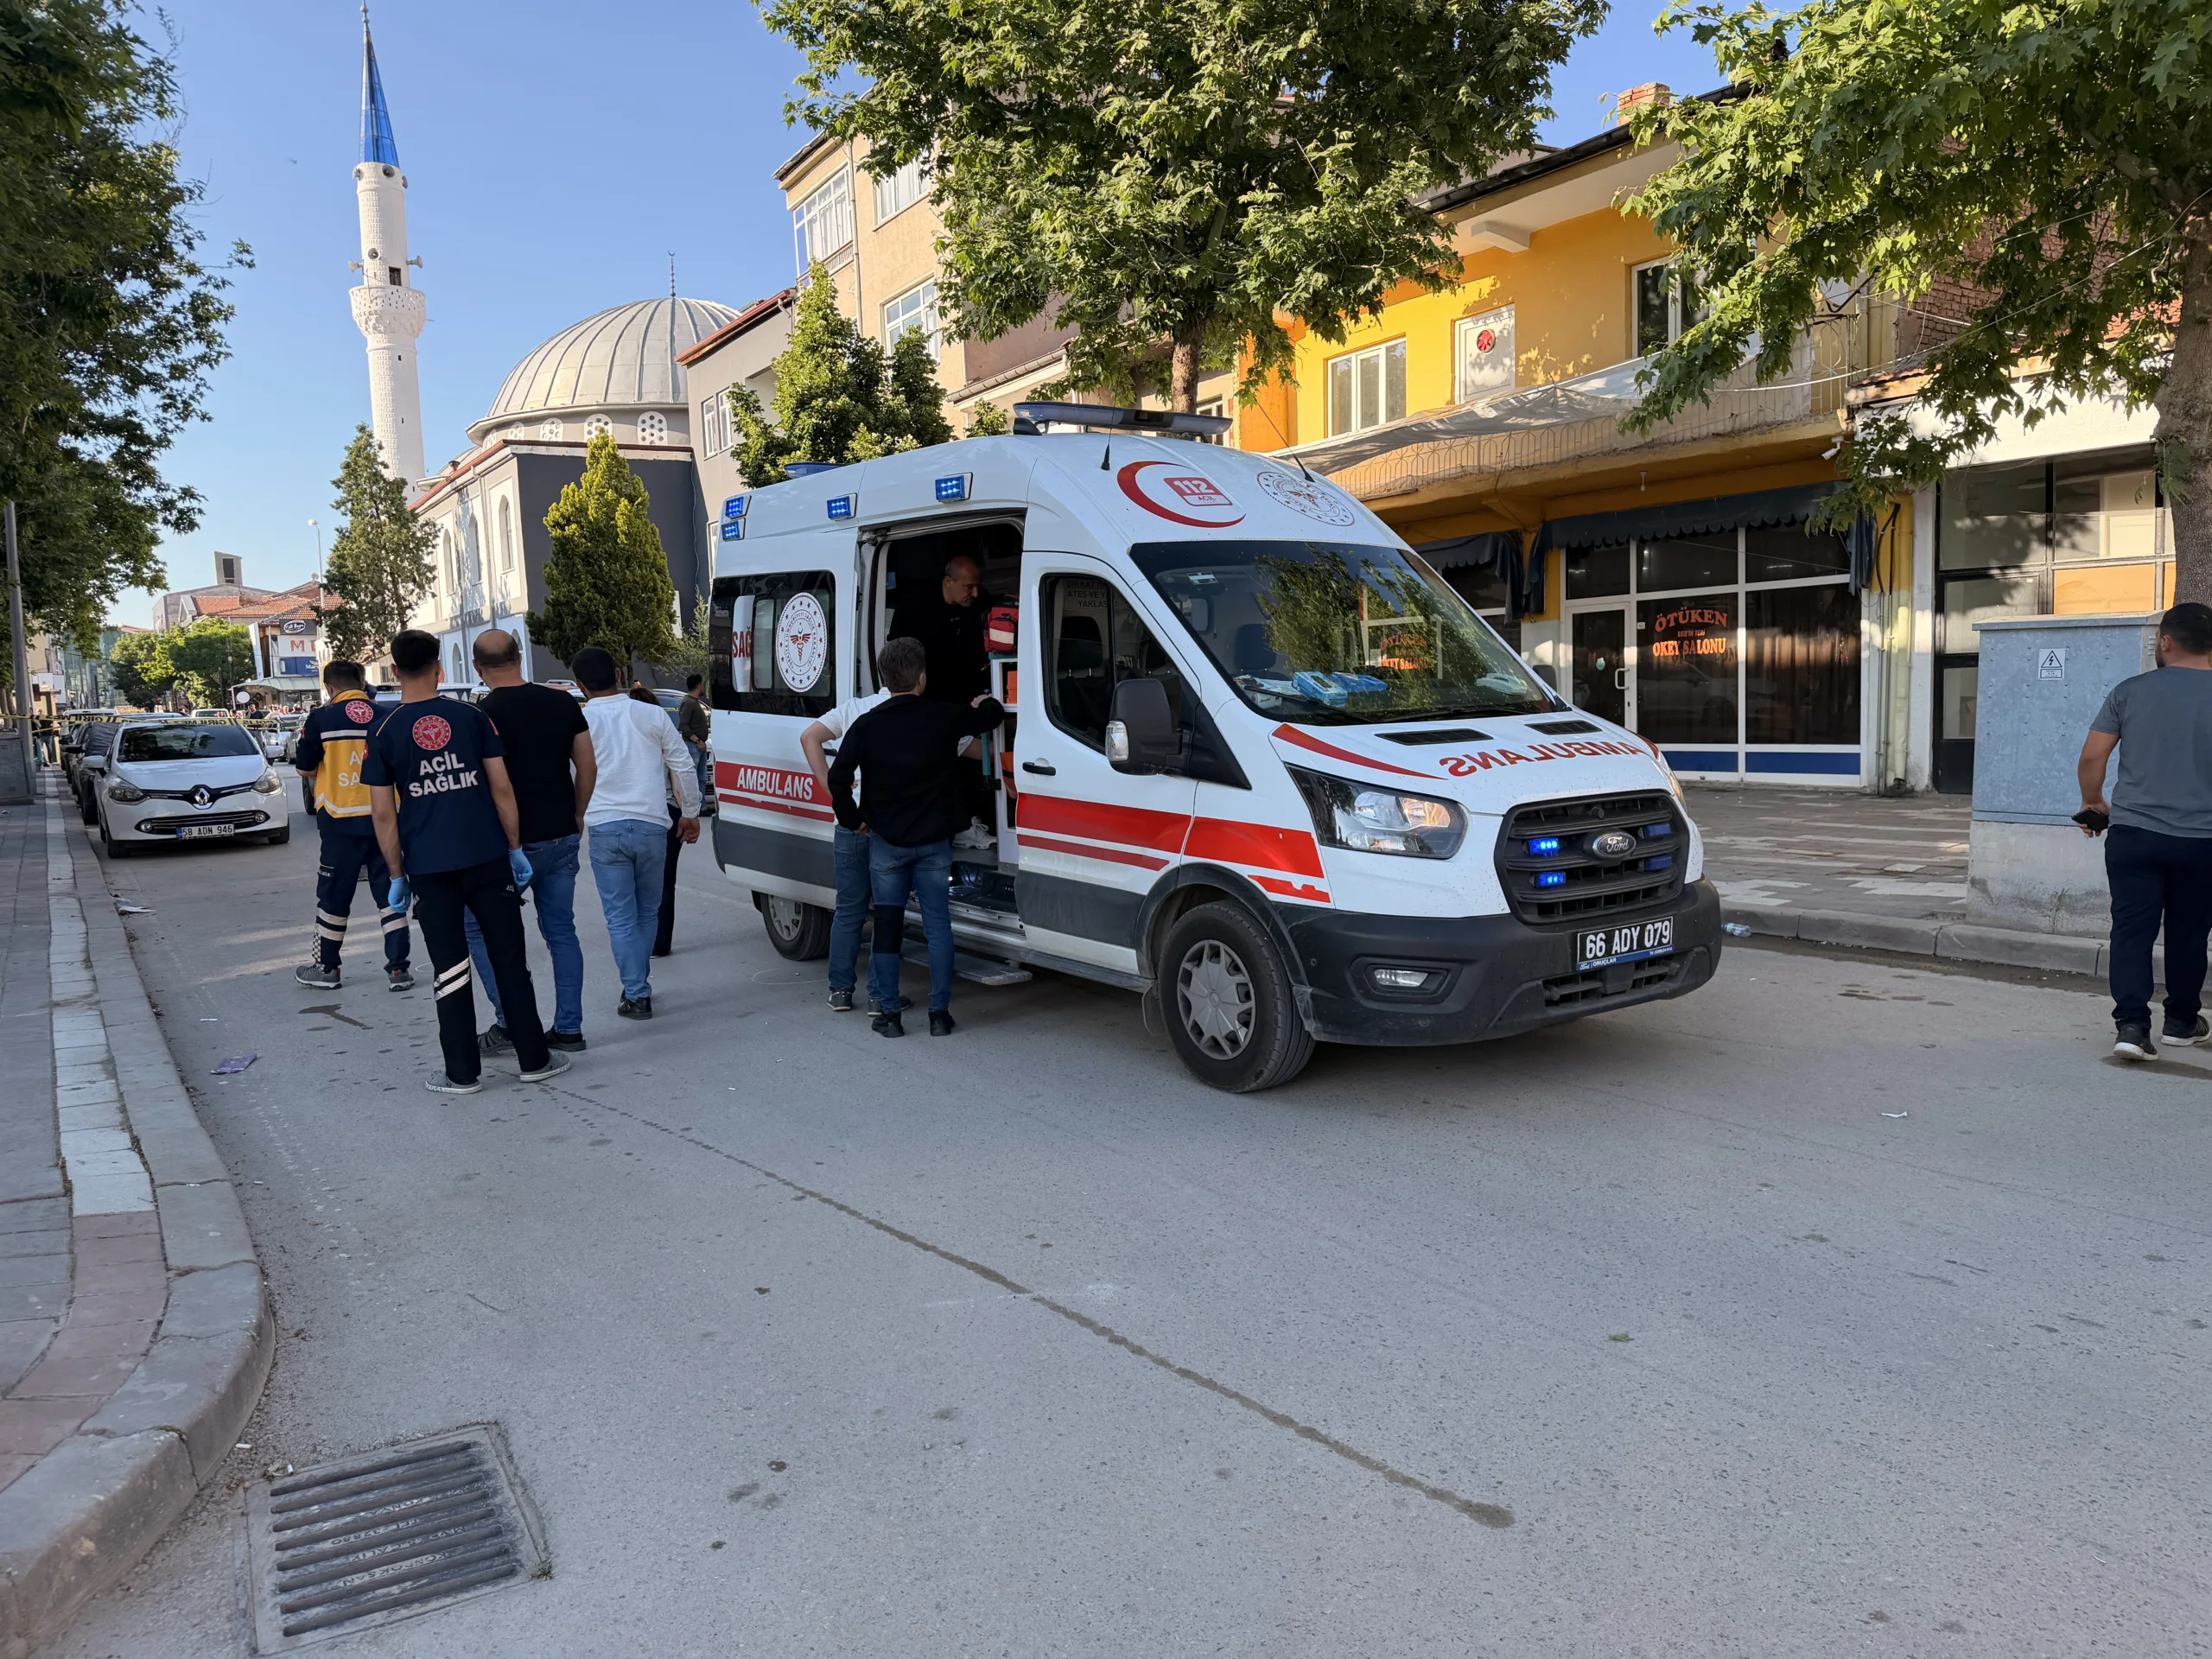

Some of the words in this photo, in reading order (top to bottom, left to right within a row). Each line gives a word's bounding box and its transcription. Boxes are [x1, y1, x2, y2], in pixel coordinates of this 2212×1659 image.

[1173, 480, 1215, 493] 112
[1655, 607, 1728, 632] ÖTÜKEN
[1652, 640, 1681, 657] OKEY
[1682, 638, 1726, 655] SALONU
[419, 751, 465, 776] ACİL
[409, 770, 479, 797] SAĞLIK
[736, 767, 813, 801] AMBULANS
[182, 828, 193, 836] 58
[197, 826, 213, 836] ADN
[217, 824, 232, 834] 946
[1606, 836, 1630, 853] Ford
[1586, 932, 1606, 959] 66
[1611, 925, 1641, 955] ADY
[1643, 920, 1670, 948] 079
[1592, 957, 1617, 967] ORUÇLAR
